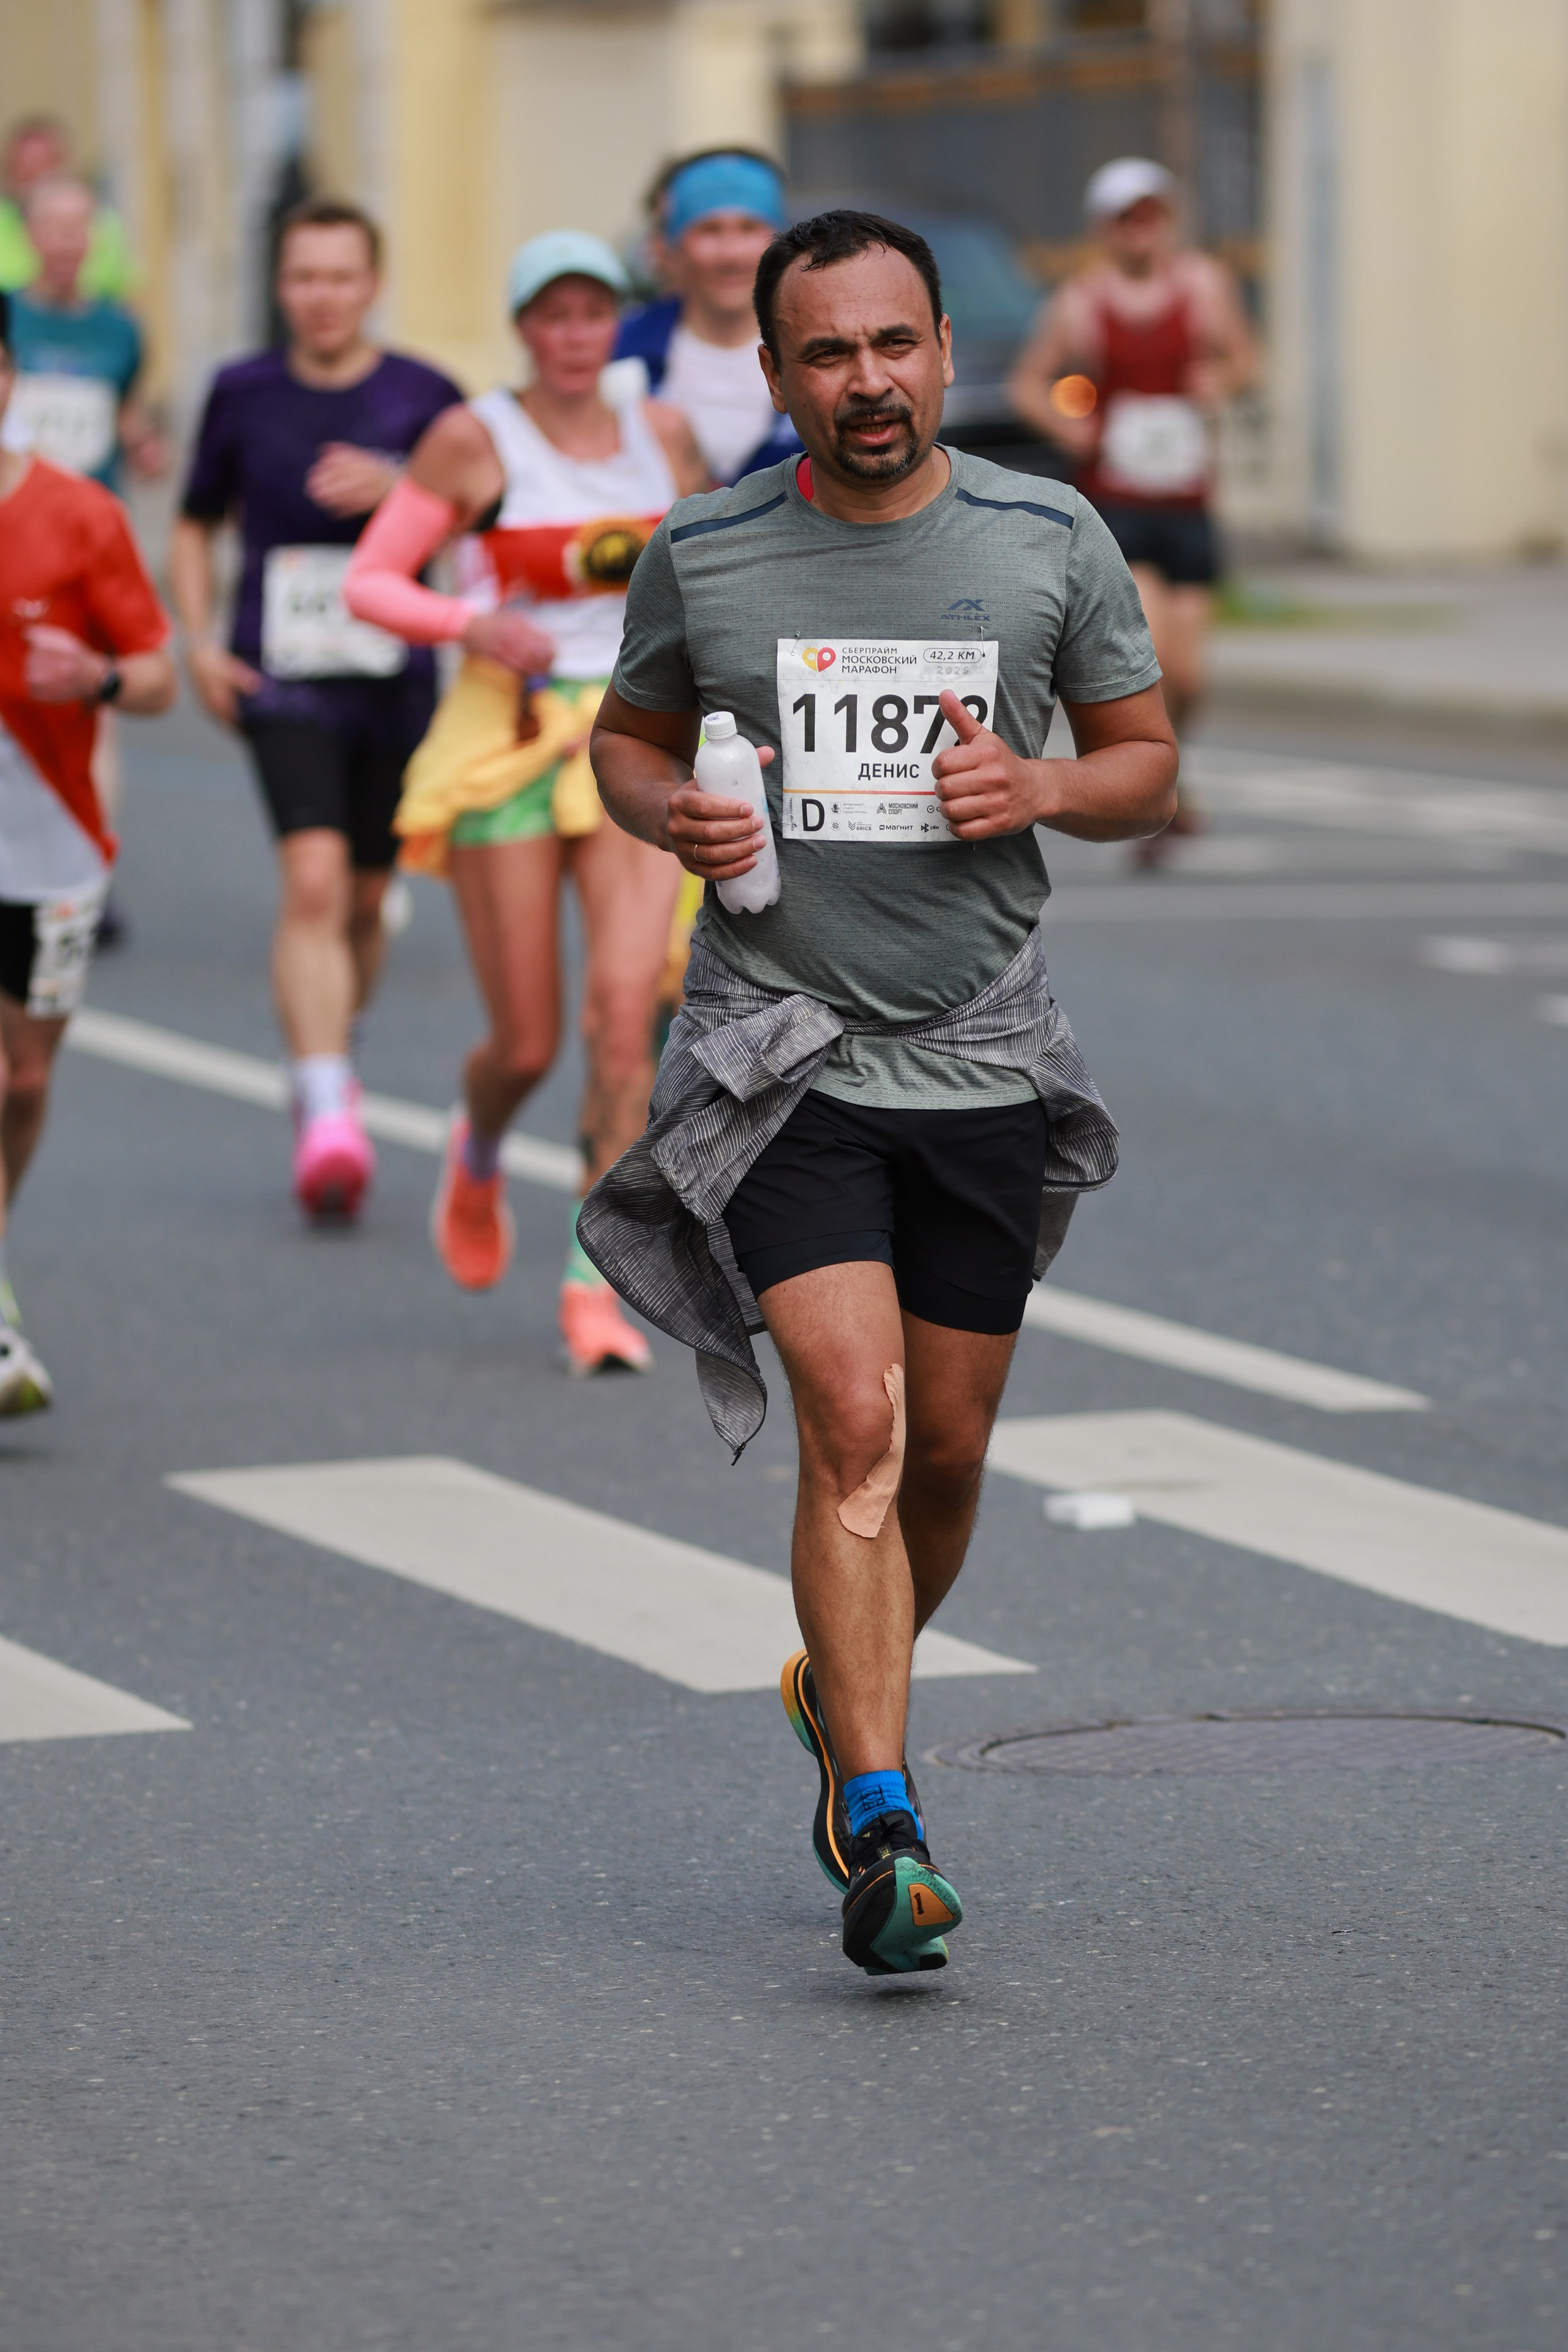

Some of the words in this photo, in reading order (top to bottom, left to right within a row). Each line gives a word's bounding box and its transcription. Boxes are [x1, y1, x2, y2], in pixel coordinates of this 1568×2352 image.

[842, 655, 917, 664] МОСКОВСКИЙ
[930, 650, 954, 661] 42,2
[842, 665, 897, 674] МАРАФОН
[937, 666, 970, 675] 2026
[858, 763, 919, 780] ДЕНИС
[802, 799, 825, 831] D
